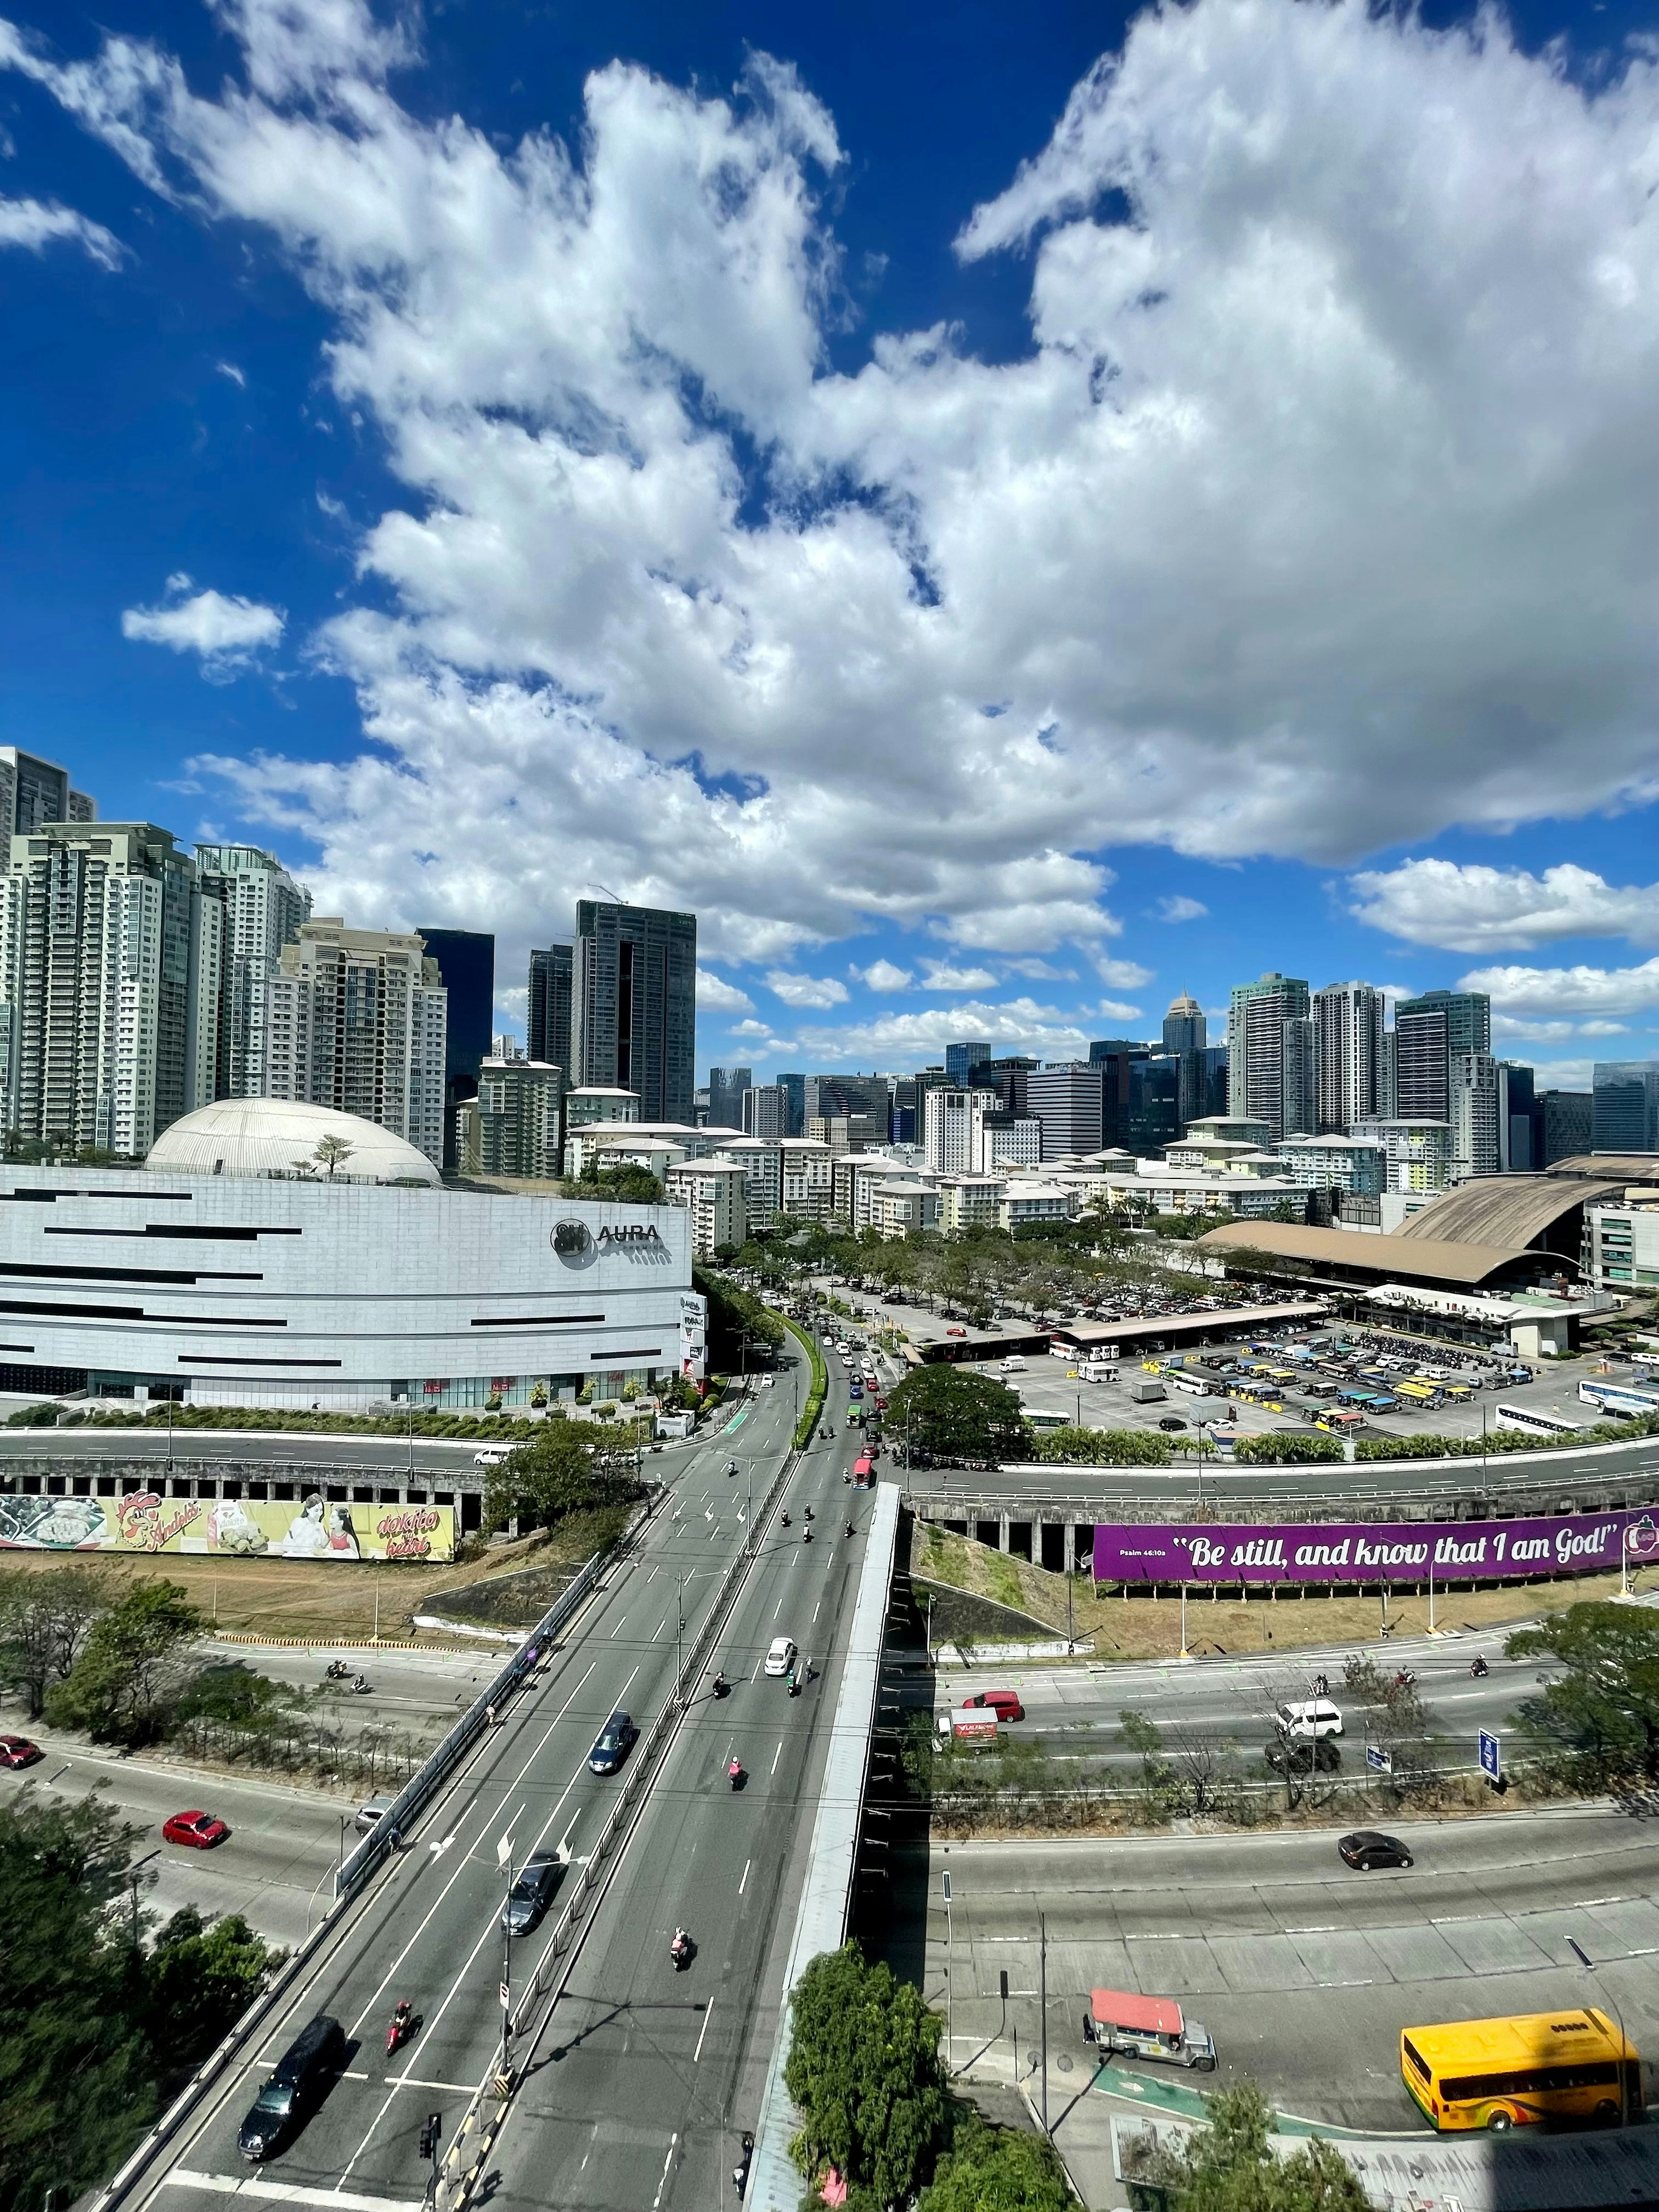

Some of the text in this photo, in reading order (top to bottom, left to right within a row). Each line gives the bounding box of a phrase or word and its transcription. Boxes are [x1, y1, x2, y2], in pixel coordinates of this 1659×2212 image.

[597, 1224, 659, 1242] AURA
[376, 1510, 438, 1535] dokito
[386, 1537, 430, 1556] heart
[1230, 1538, 1288, 1571] still,
[1295, 1538, 1350, 1566] and
[1353, 1538, 1428, 1565] know
[1434, 1536, 1487, 1564] that
[1493, 1532, 1507, 1561] I
[1511, 1538, 1550, 1560] am
